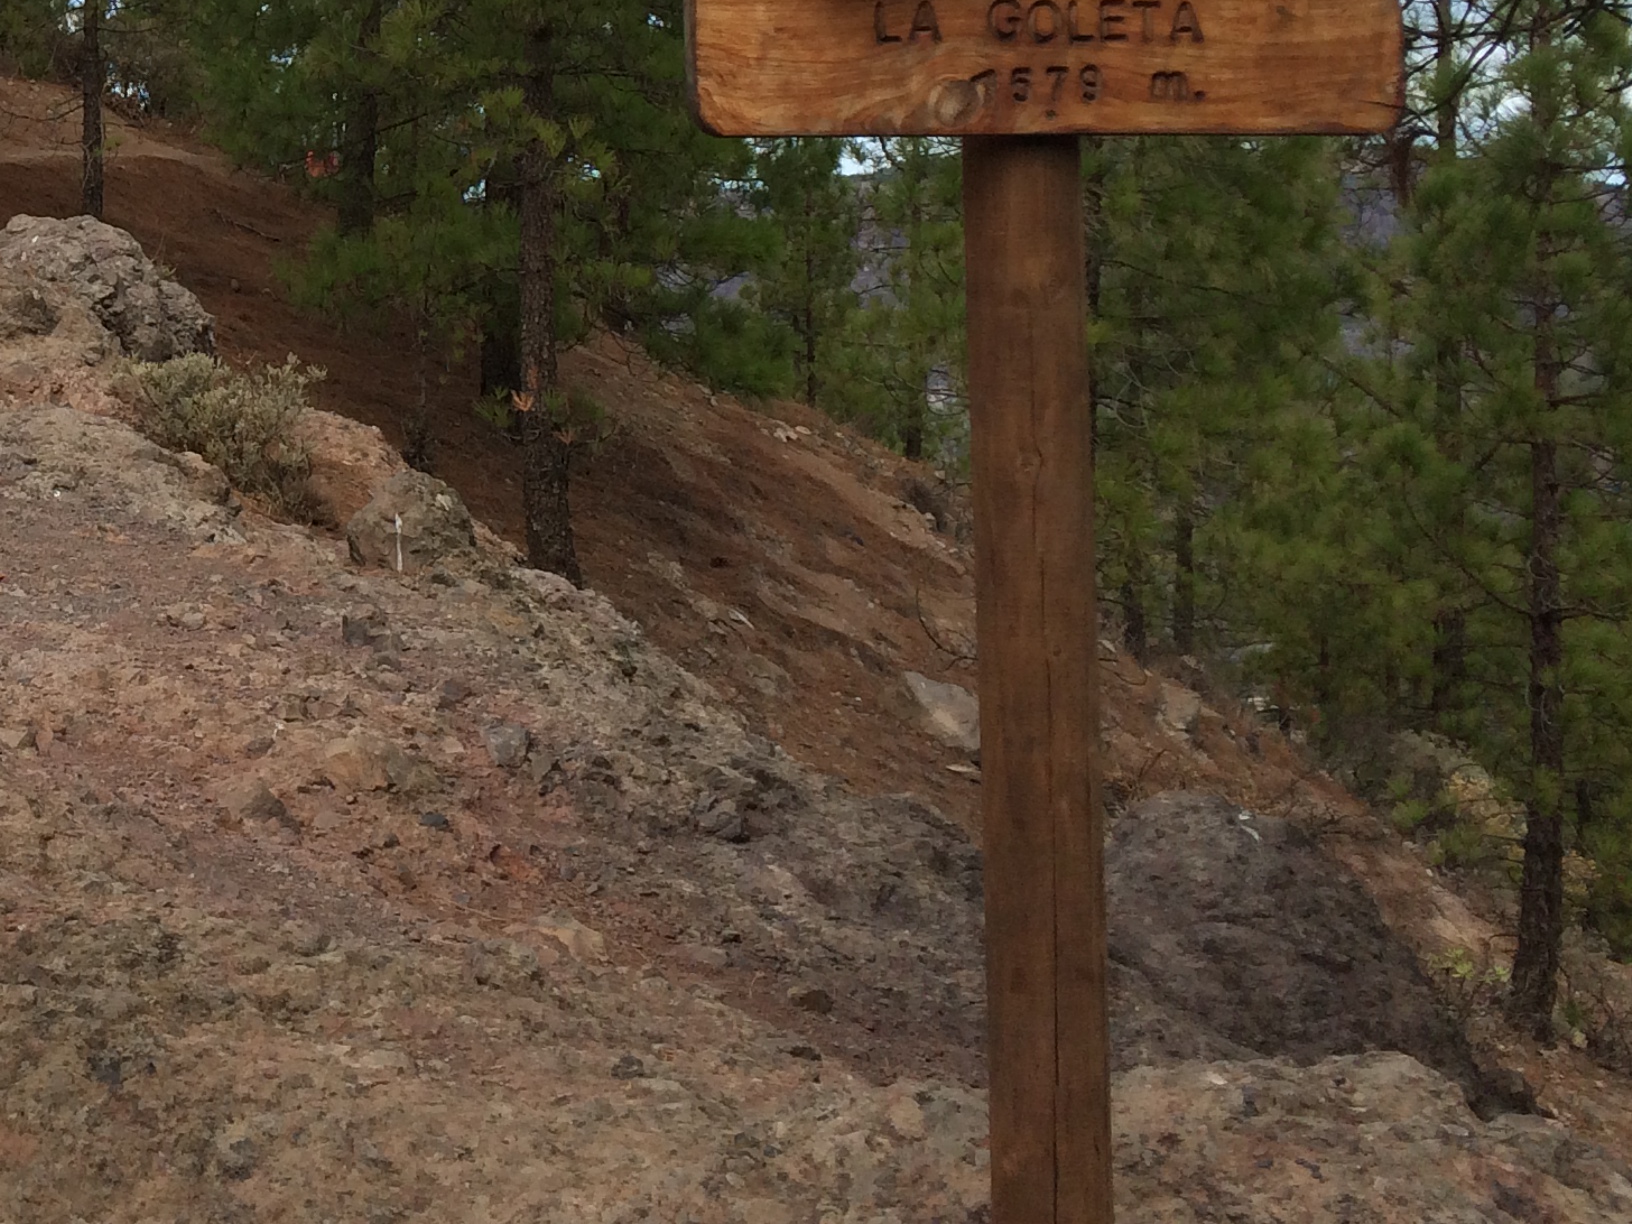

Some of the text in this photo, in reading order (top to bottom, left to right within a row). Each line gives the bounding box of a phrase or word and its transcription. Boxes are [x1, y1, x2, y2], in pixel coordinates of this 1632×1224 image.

[873, 0, 942, 45] LA
[969, 64, 1206, 103] 1579 m.
